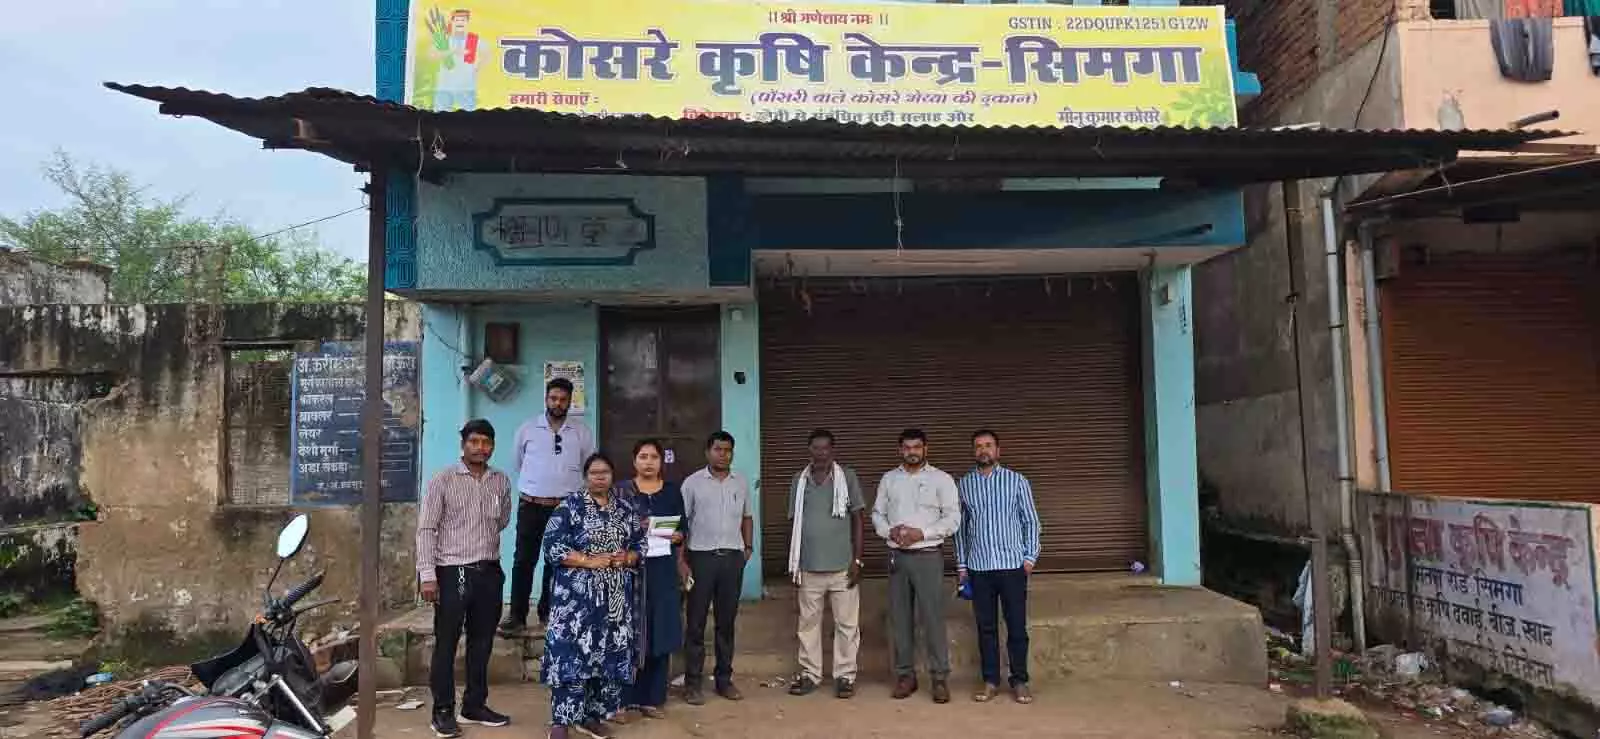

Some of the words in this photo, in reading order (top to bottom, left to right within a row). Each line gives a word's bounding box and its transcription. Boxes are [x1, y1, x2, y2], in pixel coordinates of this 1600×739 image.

[1008, 17, 1053, 30] GSTIN
[500, 27, 680, 81] कोसरे
[695, 31, 829, 96] कृषि
[510, 91, 548, 105] हमारी
[813, 90, 846, 104] वाले
[952, 91, 976, 104] की
[868, 111, 895, 123] सही
[901, 112, 942, 123] सलाह
[947, 110, 975, 123] और
[1123, 105, 1161, 123] कोसरे
[1473, 567, 1525, 606] सिमगा
